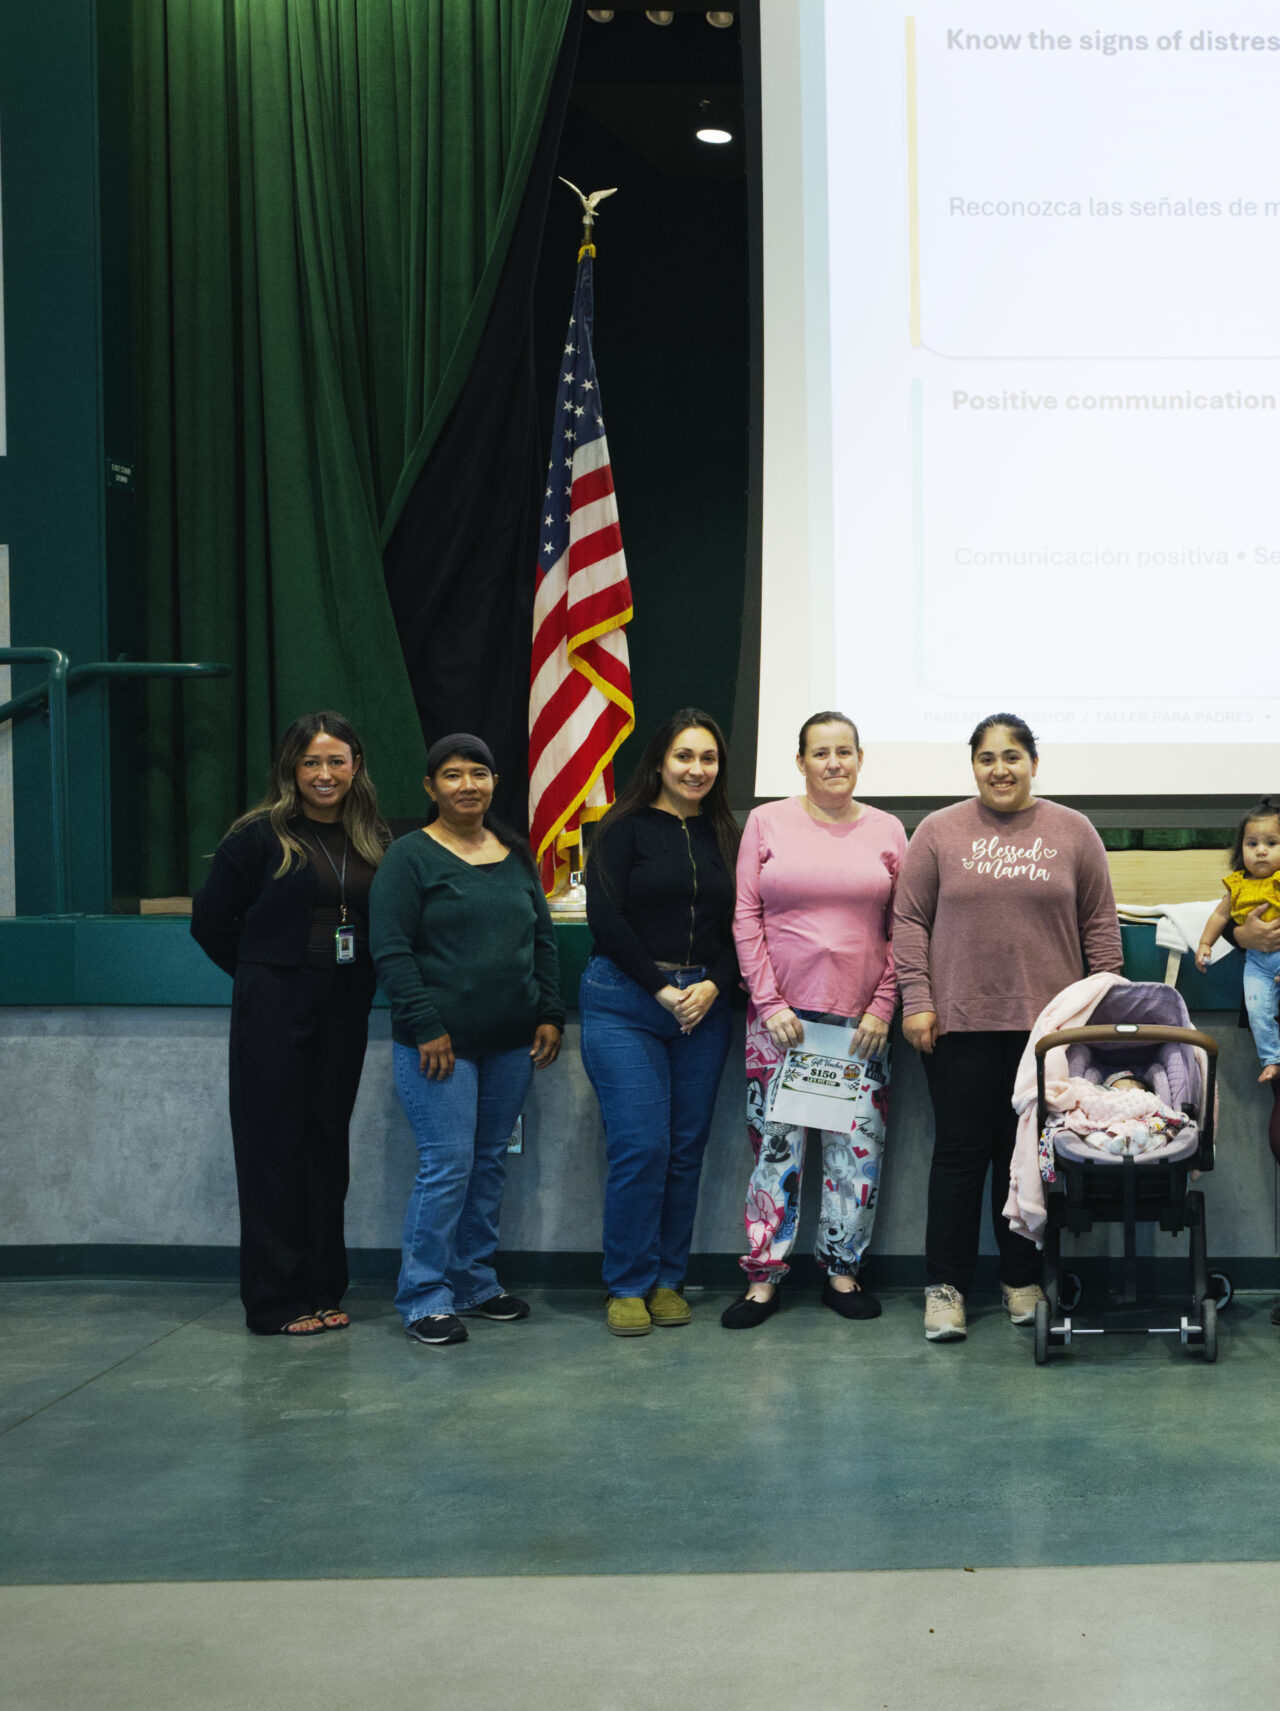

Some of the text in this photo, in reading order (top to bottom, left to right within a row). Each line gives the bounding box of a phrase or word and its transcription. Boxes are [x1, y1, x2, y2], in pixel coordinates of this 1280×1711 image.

[947, 28, 1023, 52] Know
[1028, 30, 1073, 52] the
[1080, 30, 1150, 58] signs
[1156, 30, 1184, 53] of
[950, 196, 1083, 218] Reconozca
[1089, 197, 1125, 218] las
[1130, 197, 1224, 219] señales
[1229, 197, 1260, 218] de
[952, 390, 1060, 412] Positive
[1065, 390, 1278, 412] communication
[954, 547, 1132, 568] Comunicación
[1137, 546, 1231, 571] positiva
[1096, 711, 1149, 725] TALLER
[1152, 711, 1191, 724] PARA
[1194, 711, 1255, 724] PADRES
[971, 836, 1043, 864] Blessed
[810, 1057, 824, 1067] Gift
[810, 1068, 837, 1079] $150
